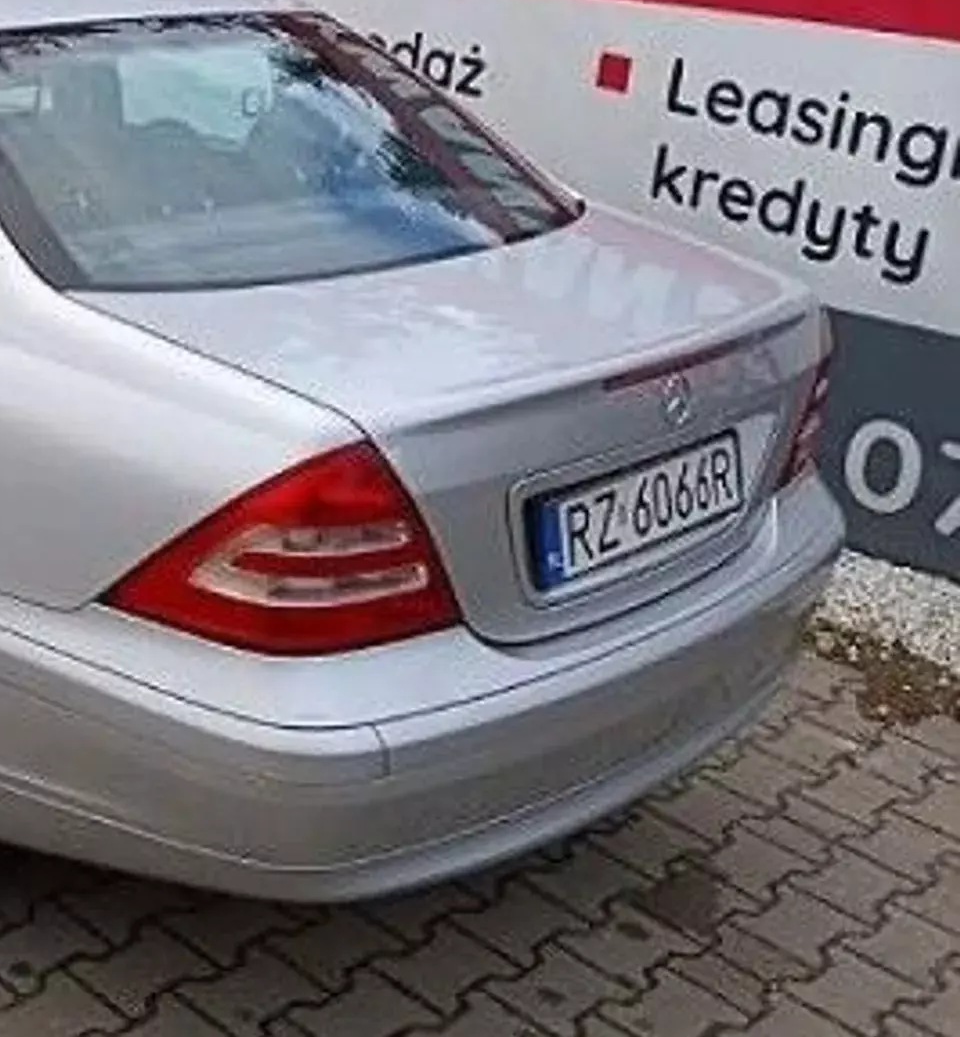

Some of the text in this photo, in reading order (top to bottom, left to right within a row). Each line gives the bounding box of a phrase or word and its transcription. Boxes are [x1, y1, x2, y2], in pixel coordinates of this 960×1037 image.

[666, 58, 948, 188] Leasing
[651, 144, 930, 286] kredyty
[568, 448, 734, 565] RZ 6066R
